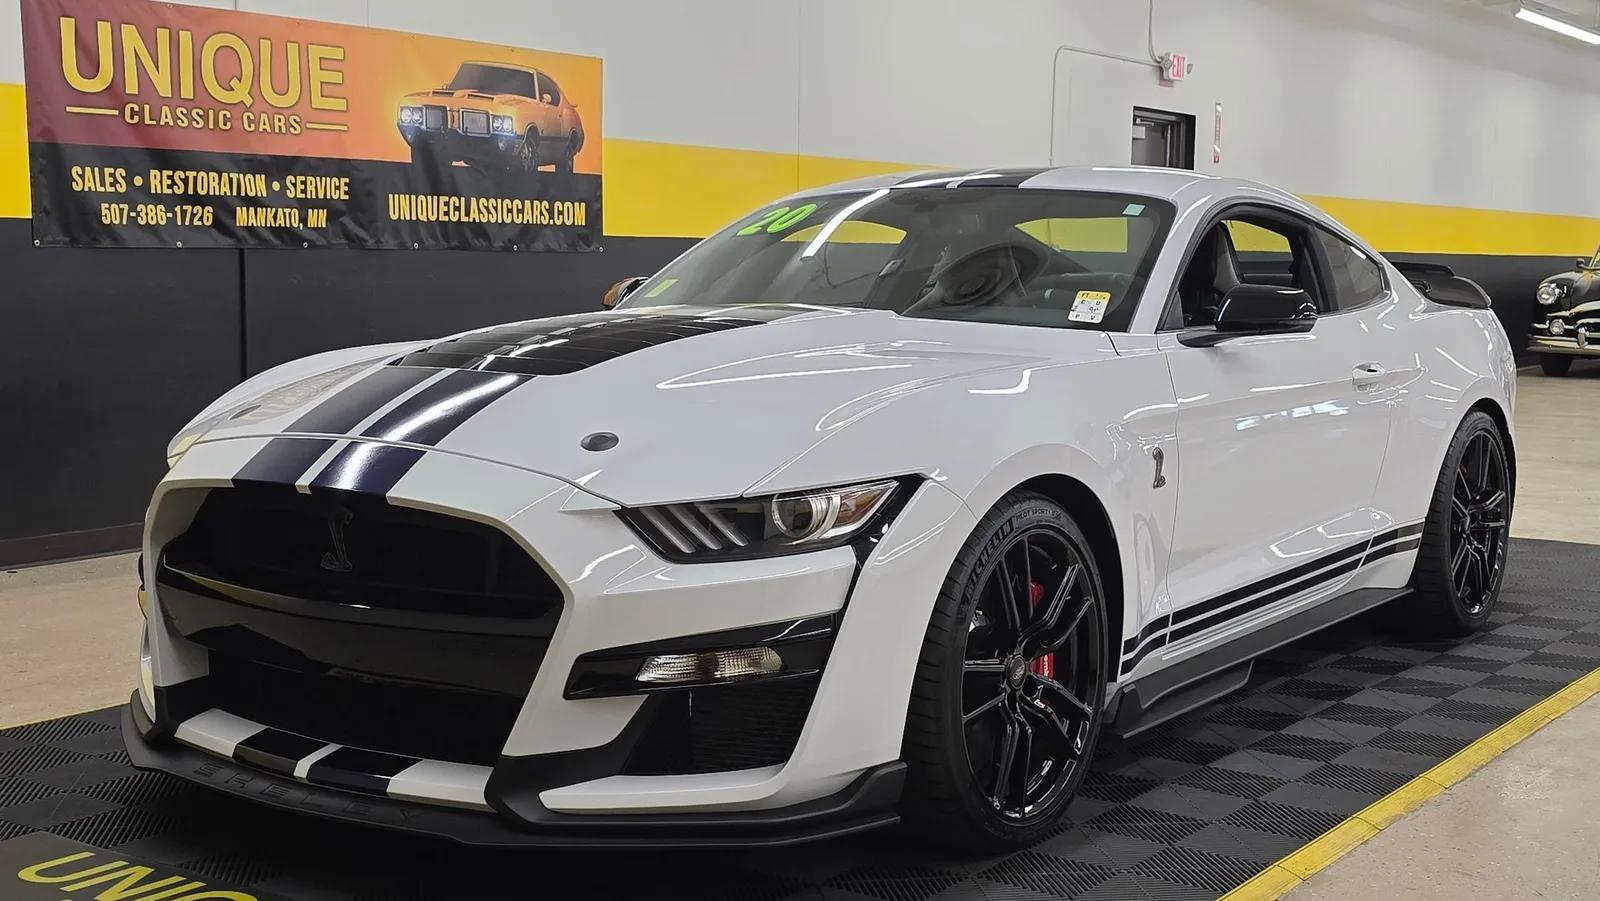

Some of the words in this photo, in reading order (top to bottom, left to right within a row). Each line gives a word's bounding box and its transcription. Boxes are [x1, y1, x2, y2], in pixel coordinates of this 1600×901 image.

[59, 16, 348, 111] UNIQUE
[124, 103, 232, 131] CLASSIC
[242, 112, 302, 135] CARS
[71, 165, 127, 193] SALES
[150, 169, 267, 197] RESTORATION
[286, 175, 350, 200] SERVICE
[100, 203, 213, 226] 507-386-1726
[235, 206, 304, 230] MANKATO,
[307, 208, 327, 228] MN
[388, 193, 586, 226] UNIQUECLASSICCARS.COM
[736, 203, 818, 236] 20
[964, 520, 1012, 602] MICHELIN
